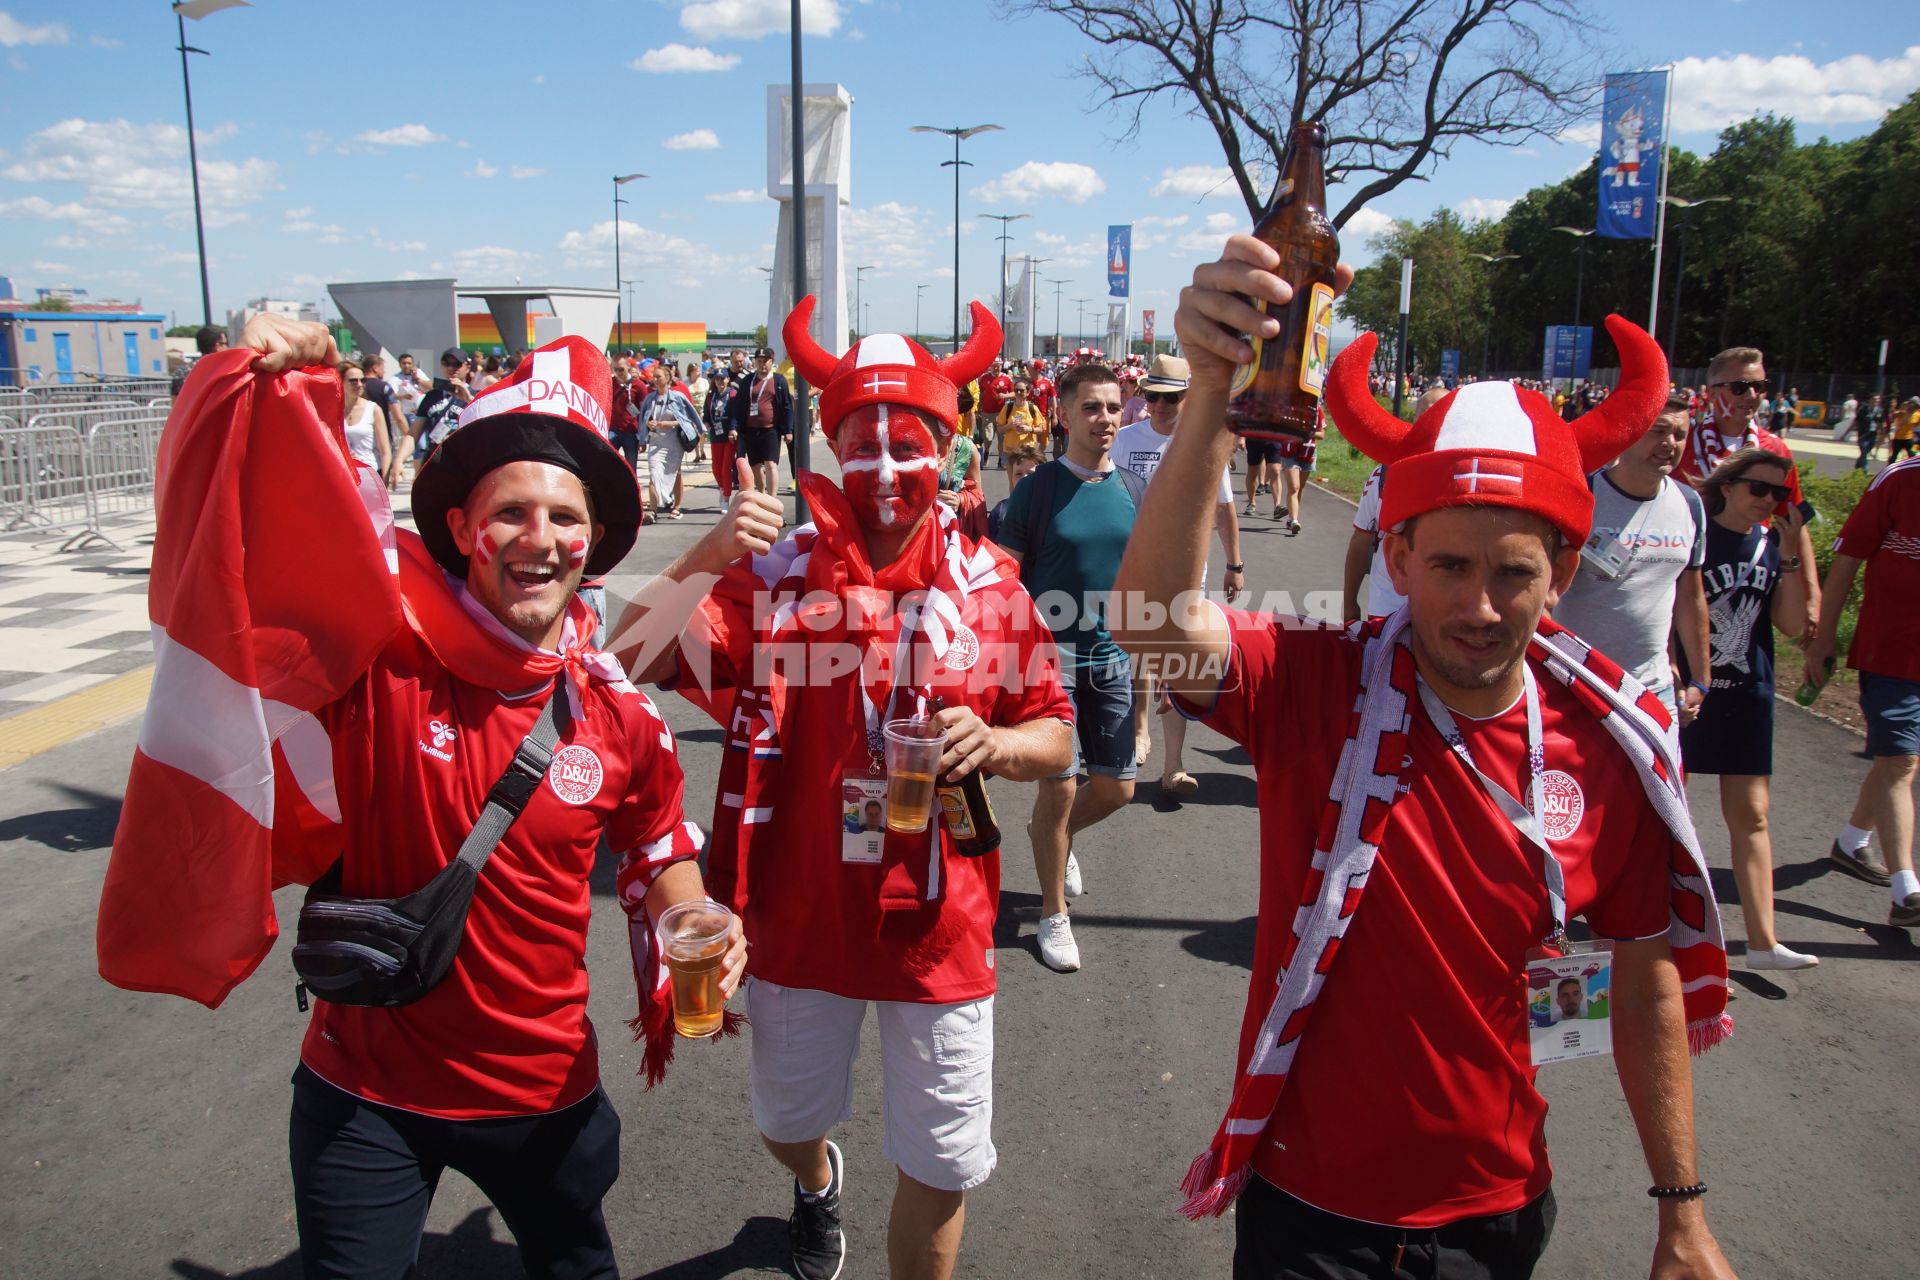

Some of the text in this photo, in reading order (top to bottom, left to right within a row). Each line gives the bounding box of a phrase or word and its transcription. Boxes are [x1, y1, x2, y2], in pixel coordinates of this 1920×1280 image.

[1704, 562, 1776, 598] IBER
[419, 739, 453, 762] hummel
[562, 764, 591, 784] DBU
[1567, 795, 1580, 829] UNION
[1544, 826, 1567, 836] 1889
